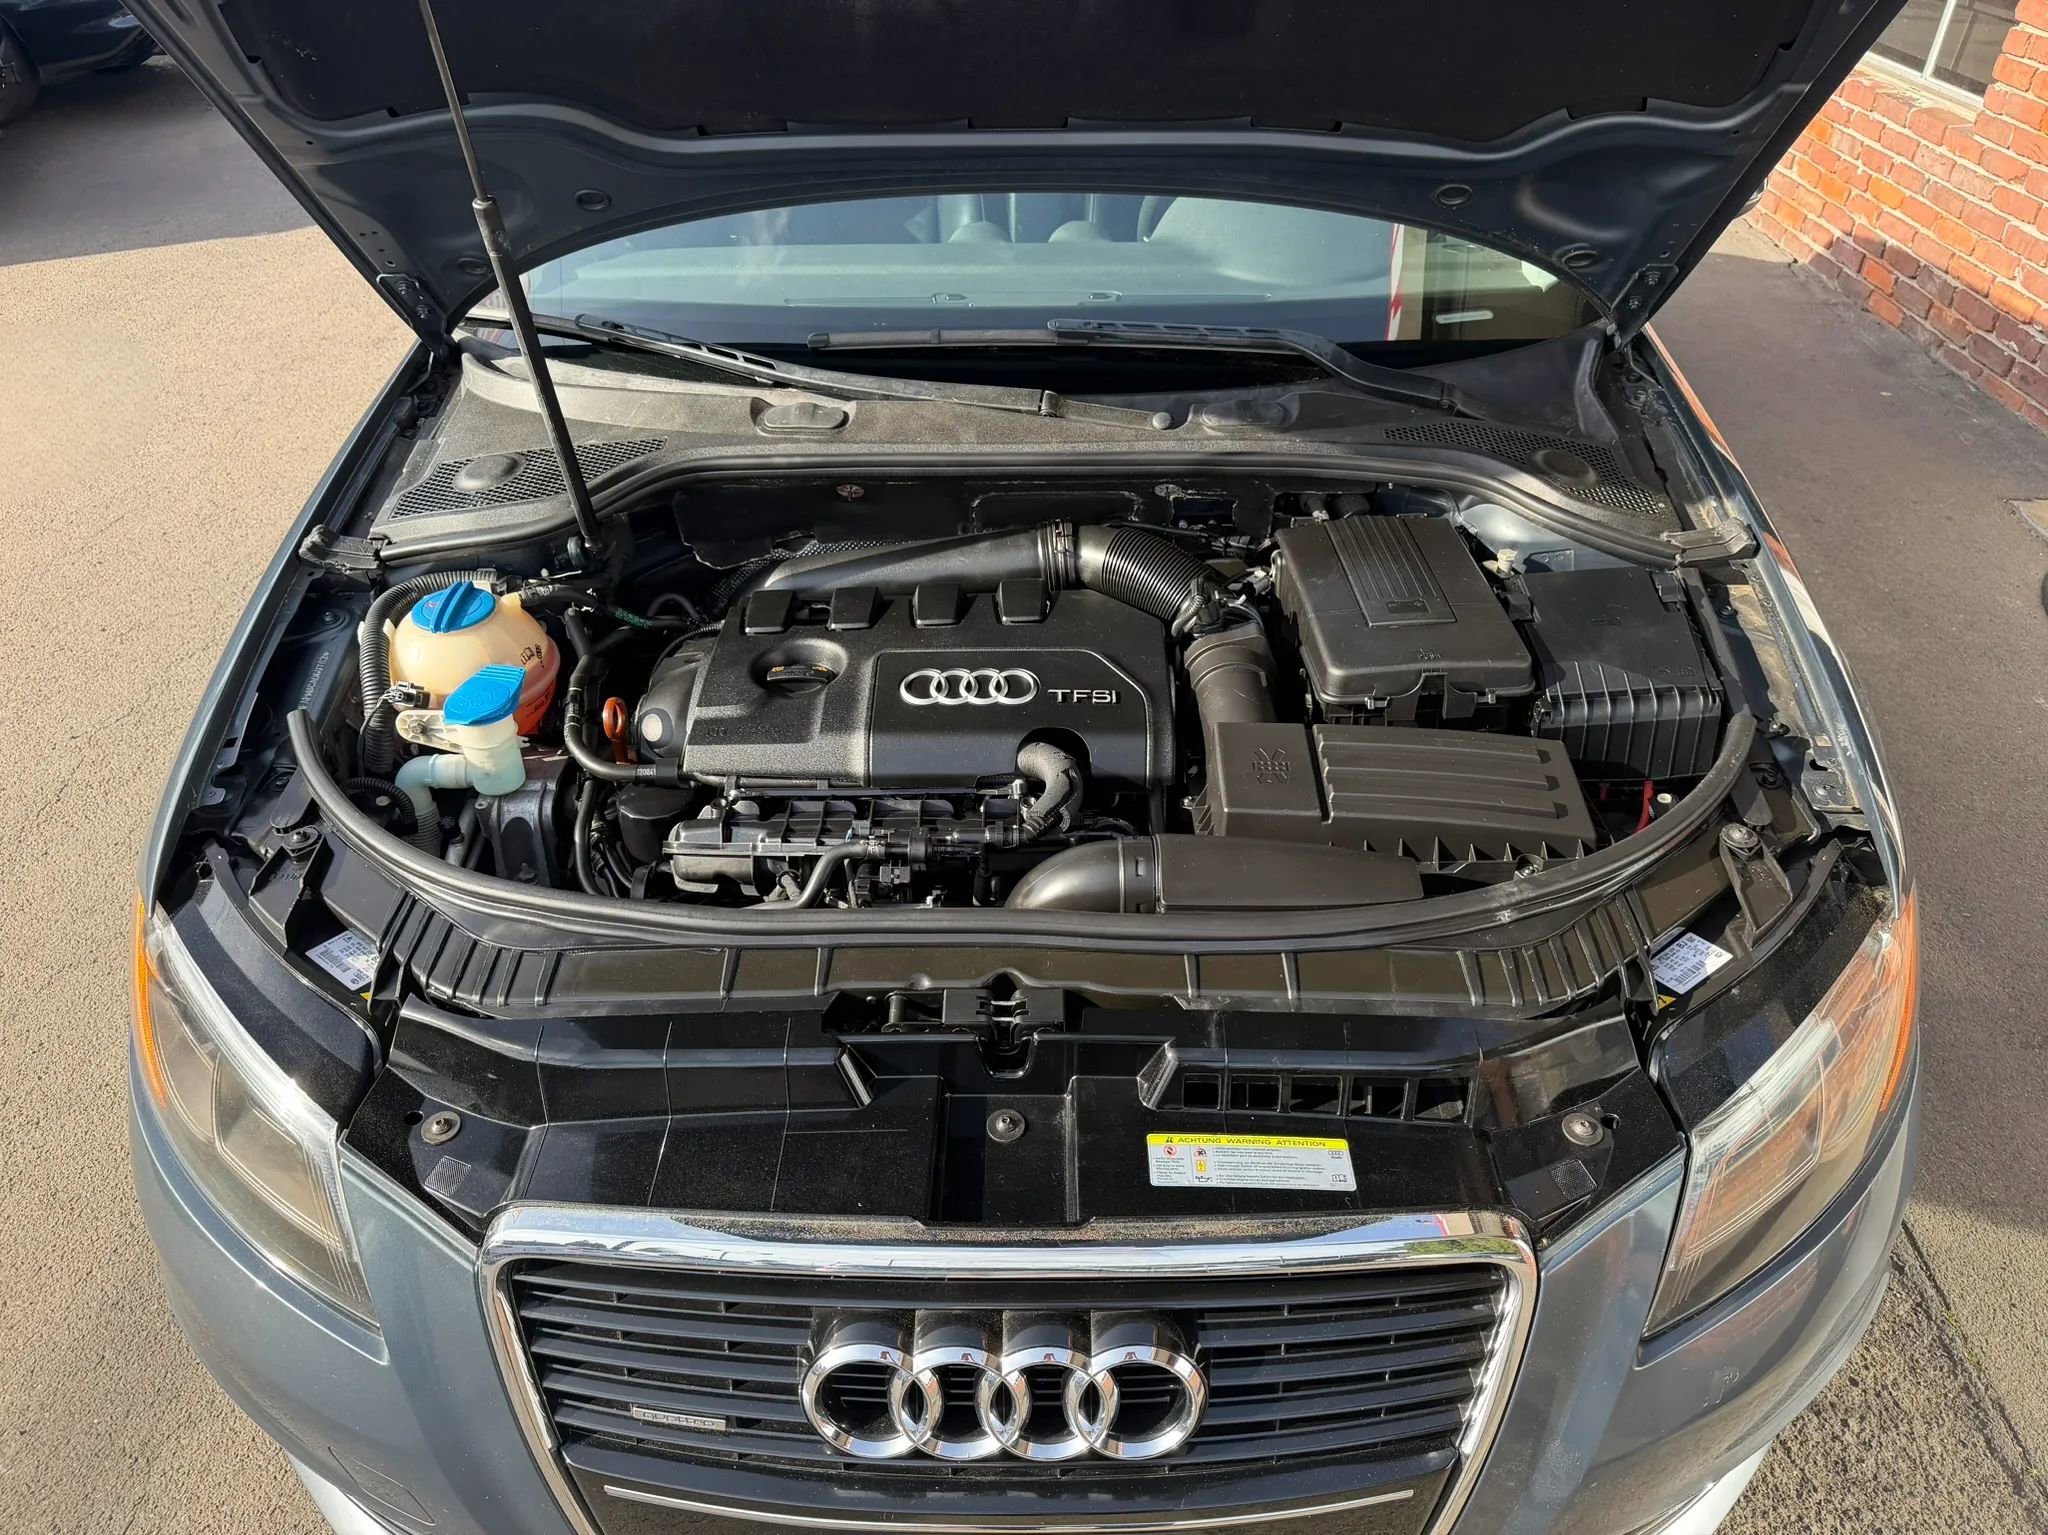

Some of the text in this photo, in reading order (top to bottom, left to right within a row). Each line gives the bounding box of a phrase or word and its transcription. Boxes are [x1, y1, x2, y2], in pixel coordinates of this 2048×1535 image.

[1047, 689, 1117, 704] TFSI
[1177, 1136, 1327, 1147] ACHTUNG WARNING ATTENTION
